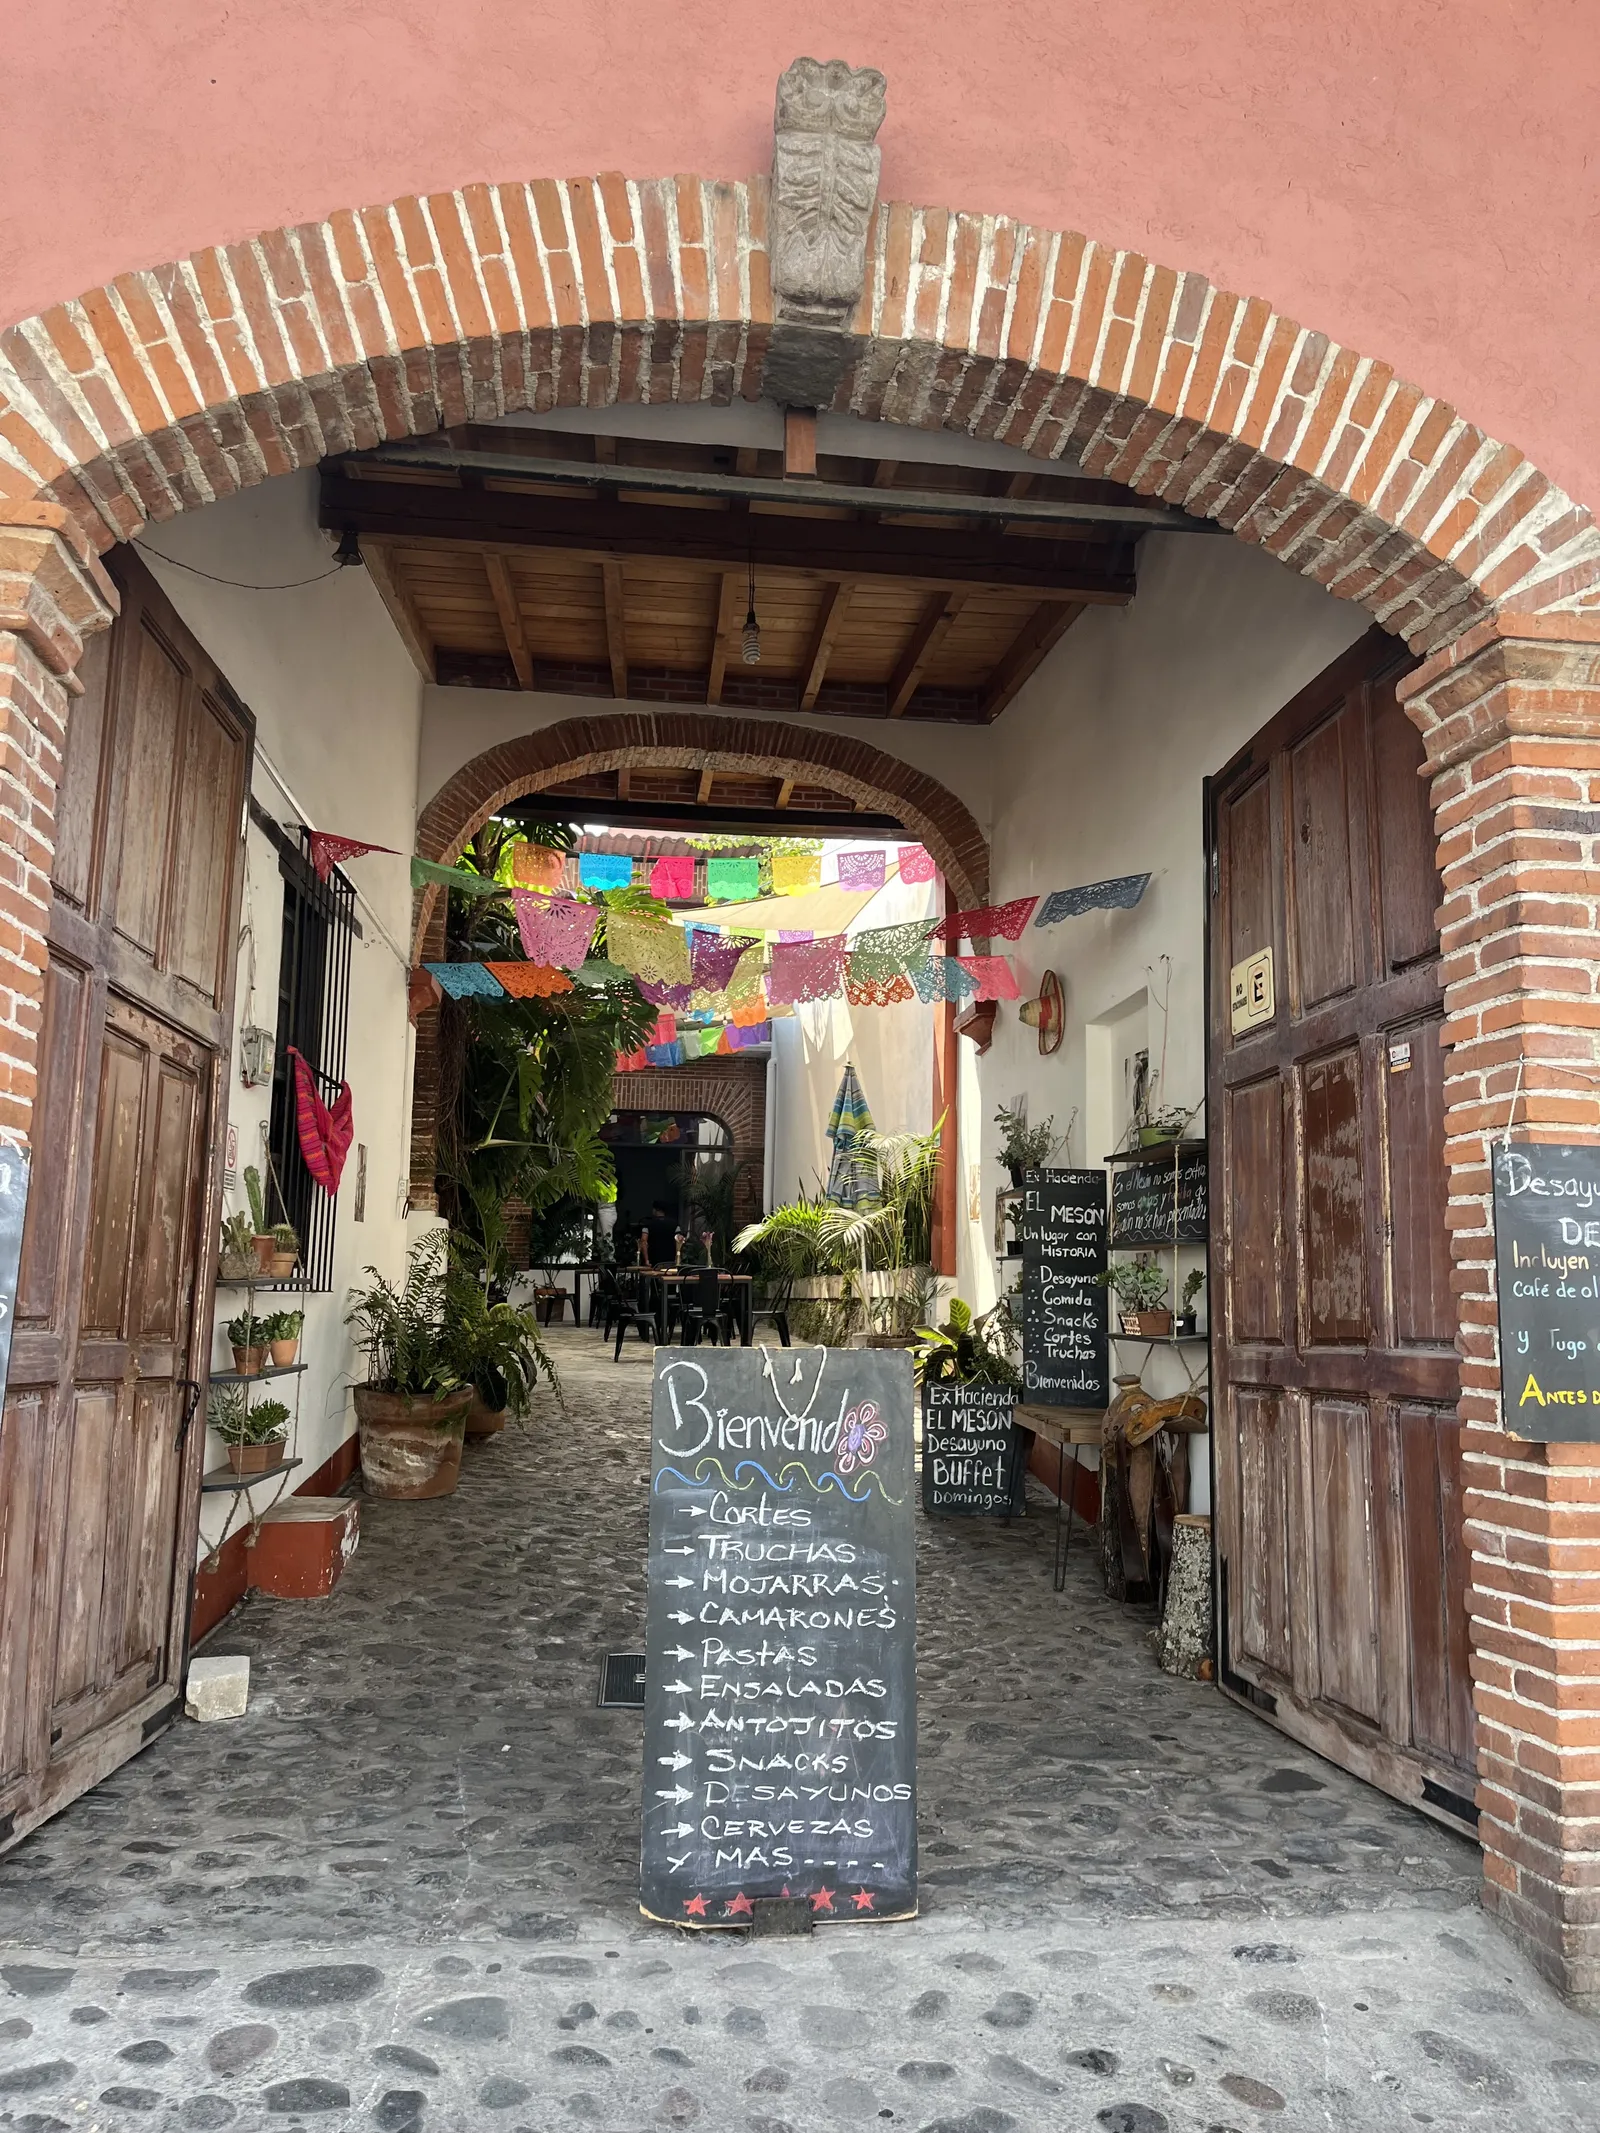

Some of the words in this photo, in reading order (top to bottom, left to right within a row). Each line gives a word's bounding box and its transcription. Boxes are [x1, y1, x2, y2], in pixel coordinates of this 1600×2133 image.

[1026, 1169, 1040, 1184] Ex
[1025, 1190, 1045, 1212] EL
[1116, 1200, 1136, 1213] somos
[1023, 1225, 1039, 1240] Un
[1040, 1225, 1069, 1245] lugar
[1075, 1231, 1098, 1242] con
[1041, 1243, 1097, 1258] HISTORIA
[1042, 1285, 1092, 1307] Comida
[1512, 1277, 1550, 1298] Café
[1556, 1281, 1577, 1298] de
[1043, 1327, 1092, 1346] Cortes
[1043, 1343, 1097, 1361] Truchas
[1024, 1360, 1100, 1390] Bienvenidos
[930, 1386, 952, 1405] Ex
[954, 1384, 1019, 1406] Hacienda
[926, 1408, 946, 1430] EL
[951, 1406, 1012, 1433] MESÓN
[927, 1433, 1007, 1457] Desayuno
[698, 1534, 857, 1563] TRUCHAS
[702, 1569, 885, 1598] MOJARRAS
[700, 1601, 897, 1630] CAMARONES
[700, 1675, 888, 1699] ENSALADAS
[699, 1708, 898, 1741] ANTOJITOS
[706, 1749, 849, 1774] SNACKS
[703, 1781, 912, 1807] DESAYUNOS
[701, 1816, 874, 1841] CERVEZAS
